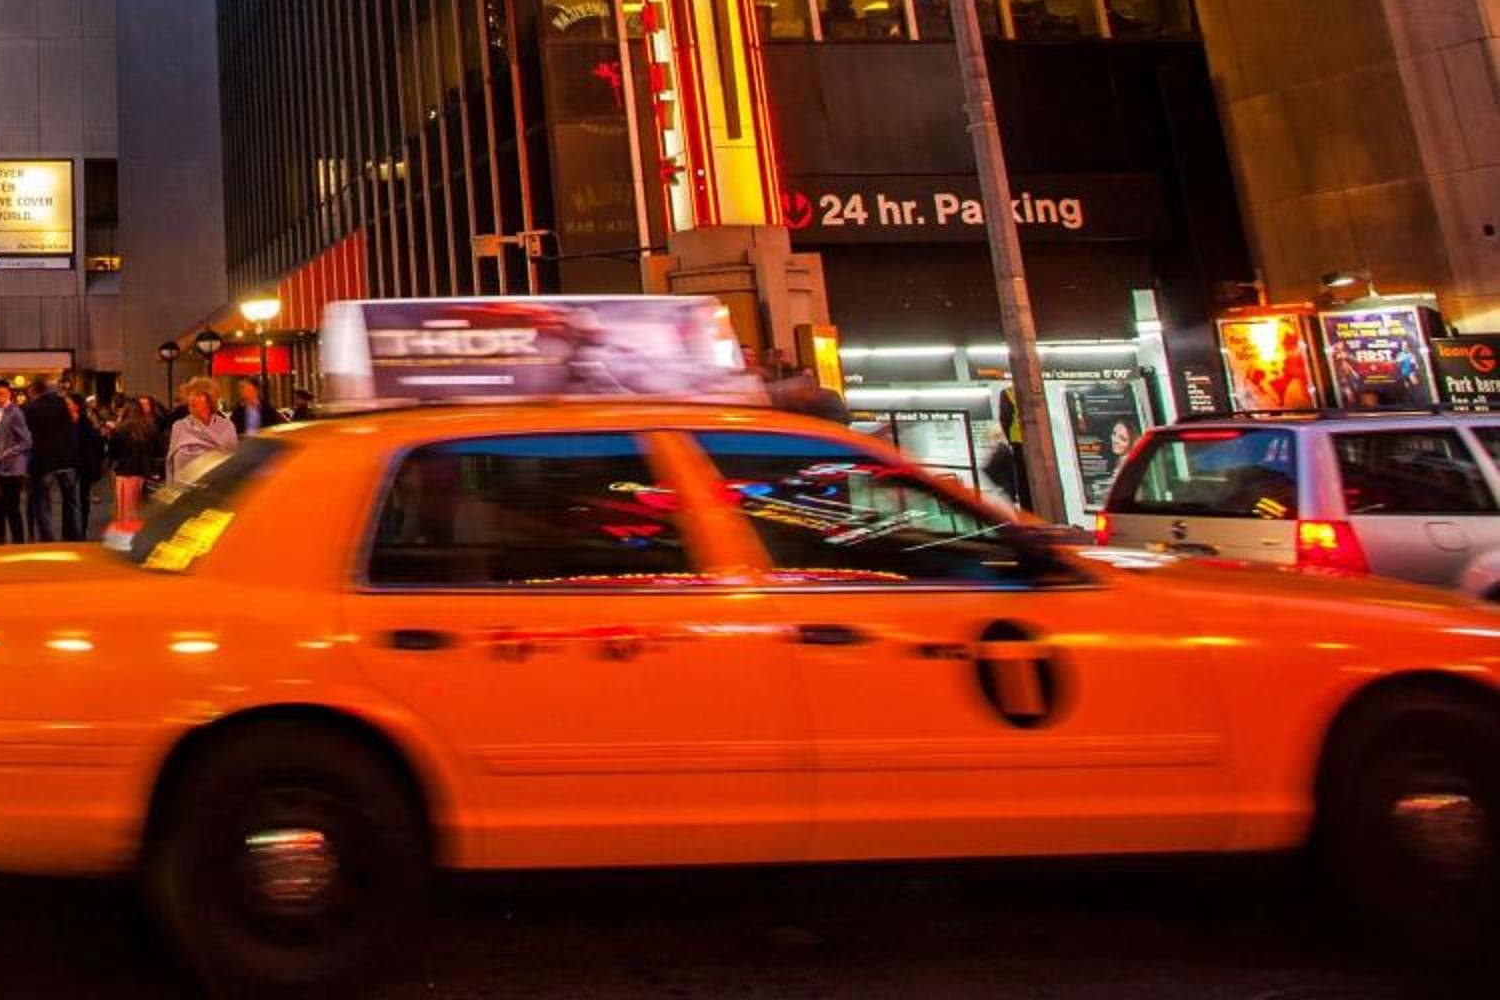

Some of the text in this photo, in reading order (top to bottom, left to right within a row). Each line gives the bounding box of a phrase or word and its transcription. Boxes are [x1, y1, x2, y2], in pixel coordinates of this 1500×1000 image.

[819, 193, 1084, 230] 24 hr. Paking
